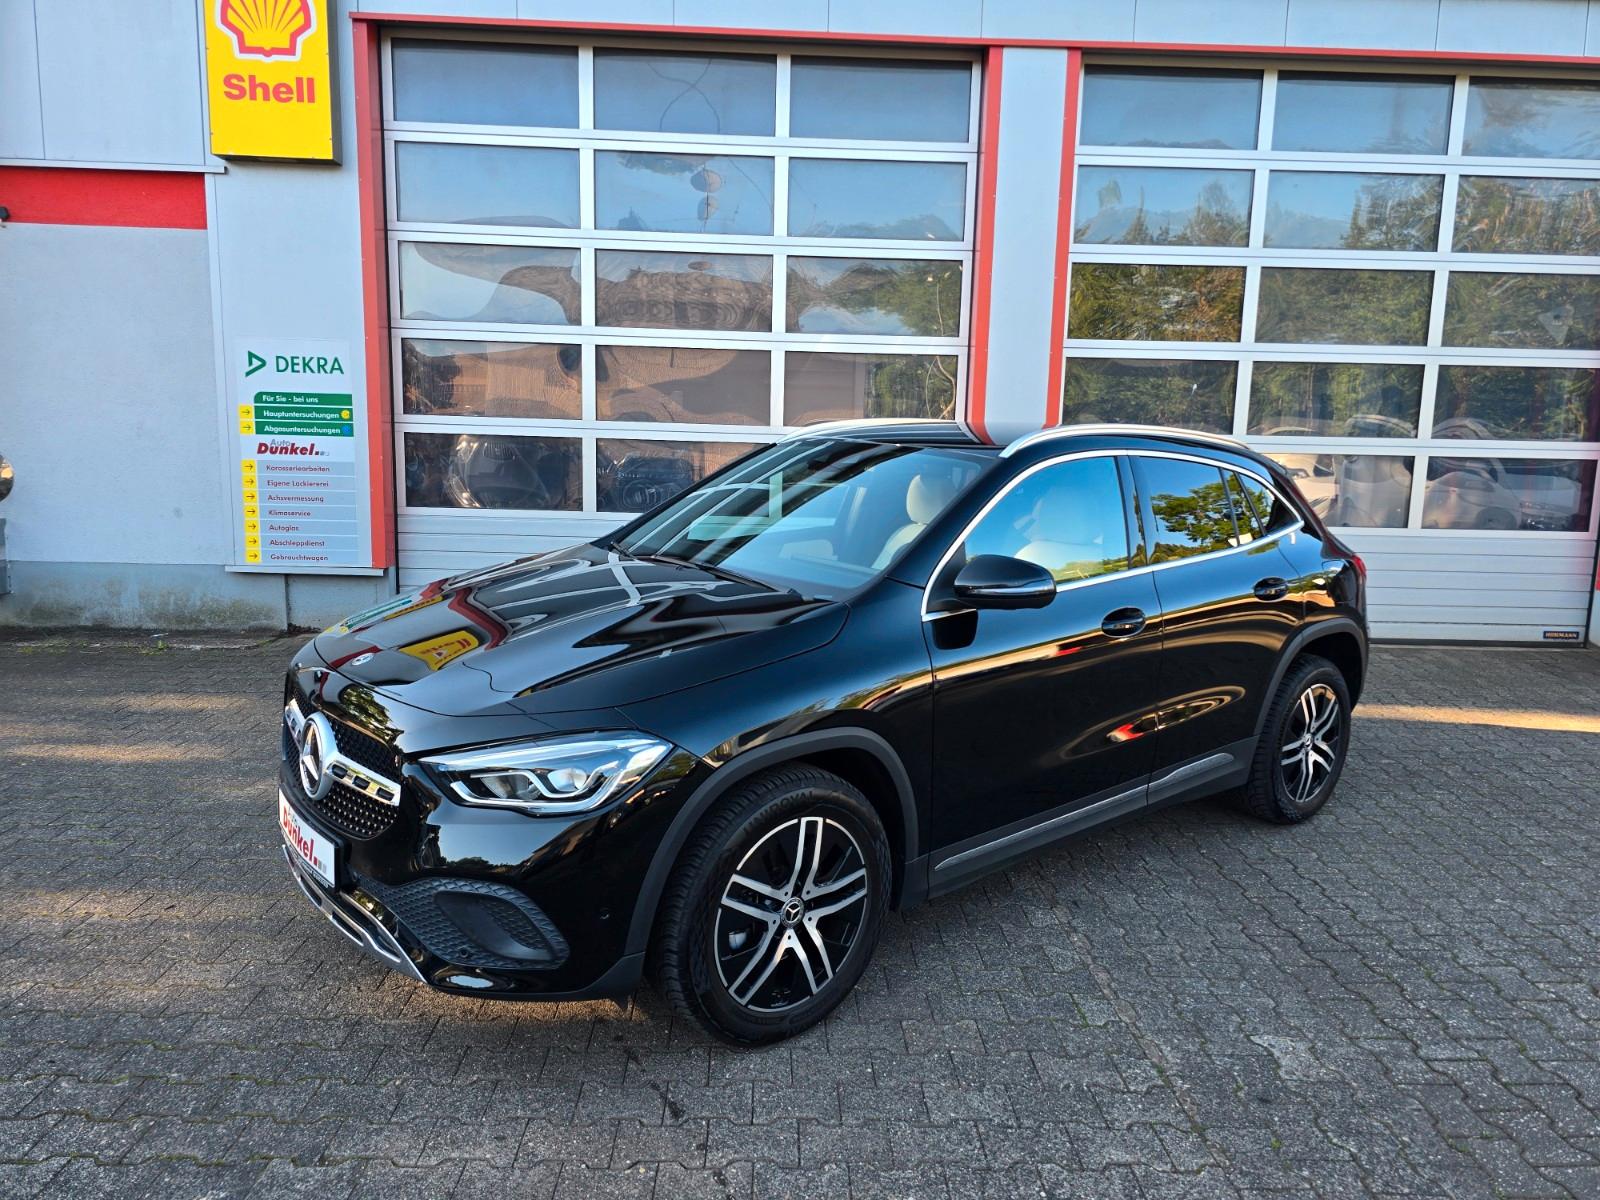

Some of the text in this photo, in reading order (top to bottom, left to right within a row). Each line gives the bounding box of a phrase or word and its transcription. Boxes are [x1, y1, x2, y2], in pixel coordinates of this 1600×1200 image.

[223, 73, 316, 104] Shell
[275, 355, 345, 375] DEKRA
[262, 394, 275, 402] Für
[276, 395, 287, 403] Sie
[293, 395, 305, 403] bei
[263, 409, 340, 420] Hauptuntersuchungen
[264, 425, 341, 435] Abgasuntersuchungen
[267, 480, 290, 488] Eigene
[267, 494, 324, 503] Achsvermessung
[268, 509, 311, 517] Klimaservice
[269, 539, 325, 547] Abschleppdienst
[270, 554, 329, 562] Gebrauchtwagen
